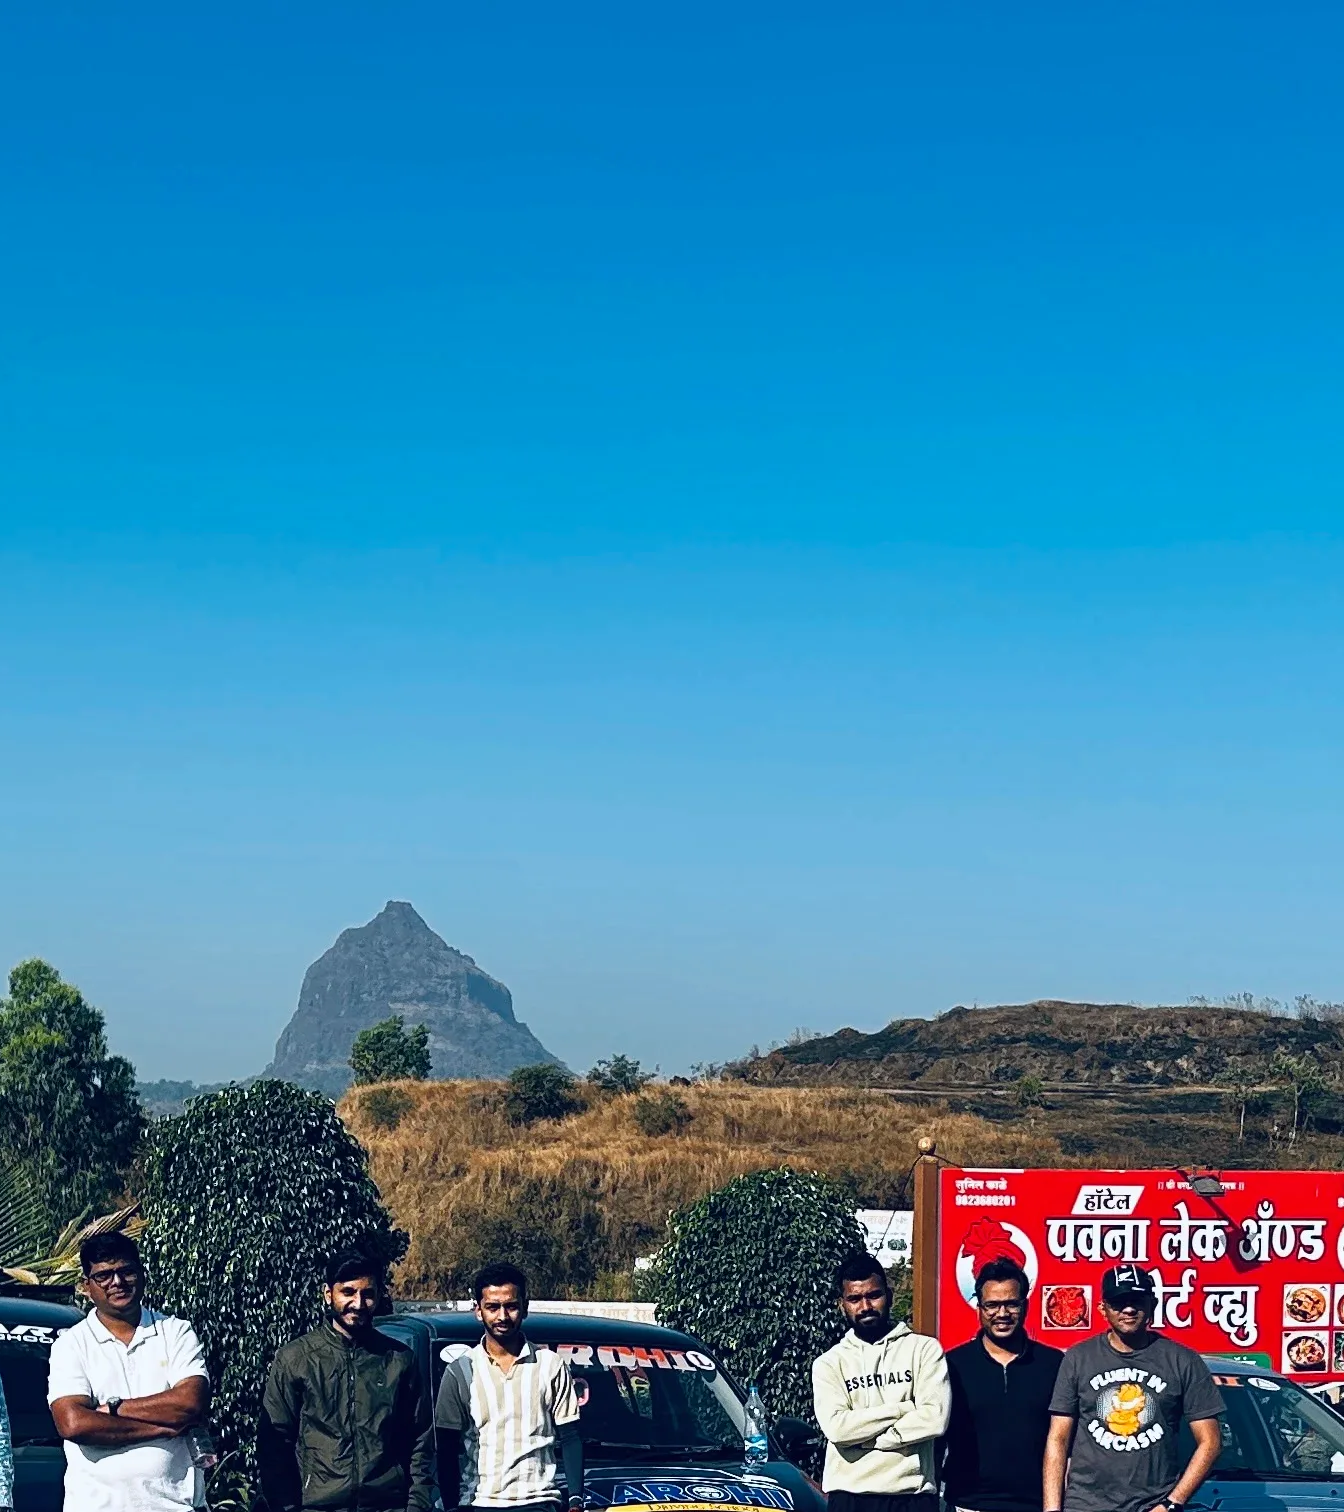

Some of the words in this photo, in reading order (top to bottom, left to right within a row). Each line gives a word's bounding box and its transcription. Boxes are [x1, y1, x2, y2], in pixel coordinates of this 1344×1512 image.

[1084, 1187, 1132, 1212] हॉटेल
[1045, 1218, 1151, 1262] पवना
[1159, 1201, 1230, 1262] लेक
[1089, 1367, 1149, 1391] FLUENT
[1146, 1374, 1167, 1393] IN
[1087, 1419, 1165, 1452] SARCASM
